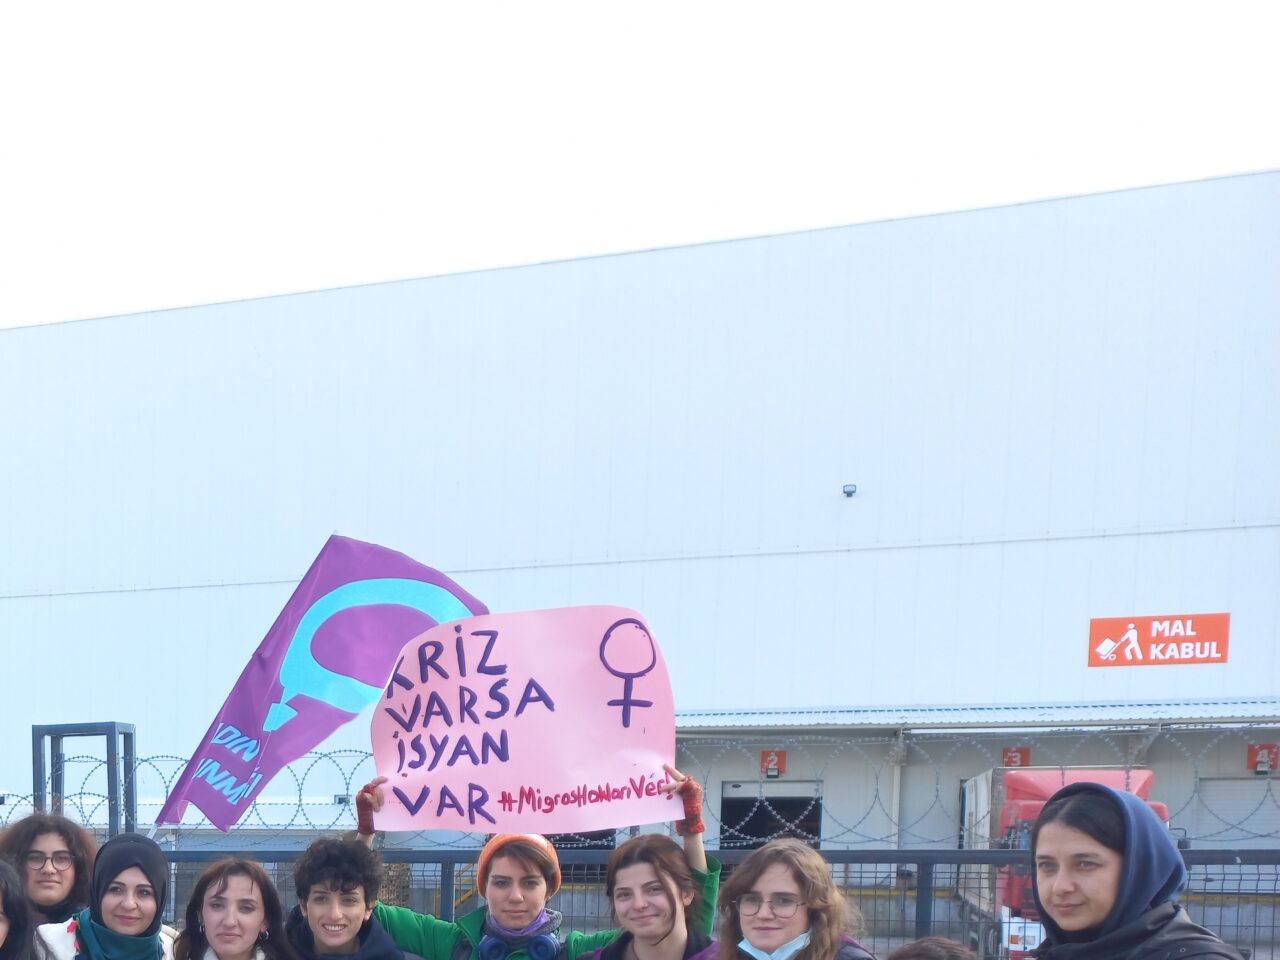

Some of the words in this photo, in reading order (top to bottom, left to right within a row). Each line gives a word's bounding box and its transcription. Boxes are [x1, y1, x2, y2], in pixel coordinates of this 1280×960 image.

[1151, 619, 1197, 637] MAL
[387, 624, 508, 699] KRİZ
[1149, 641, 1222, 660] KABUL
[385, 677, 555, 732] VARSA
[211, 722, 261, 762] DIN
[392, 729, 510, 773] İSYAN
[767, 754, 779, 769] 2
[1008, 751, 1022, 767] 3
[392, 783, 496, 824] VAR
